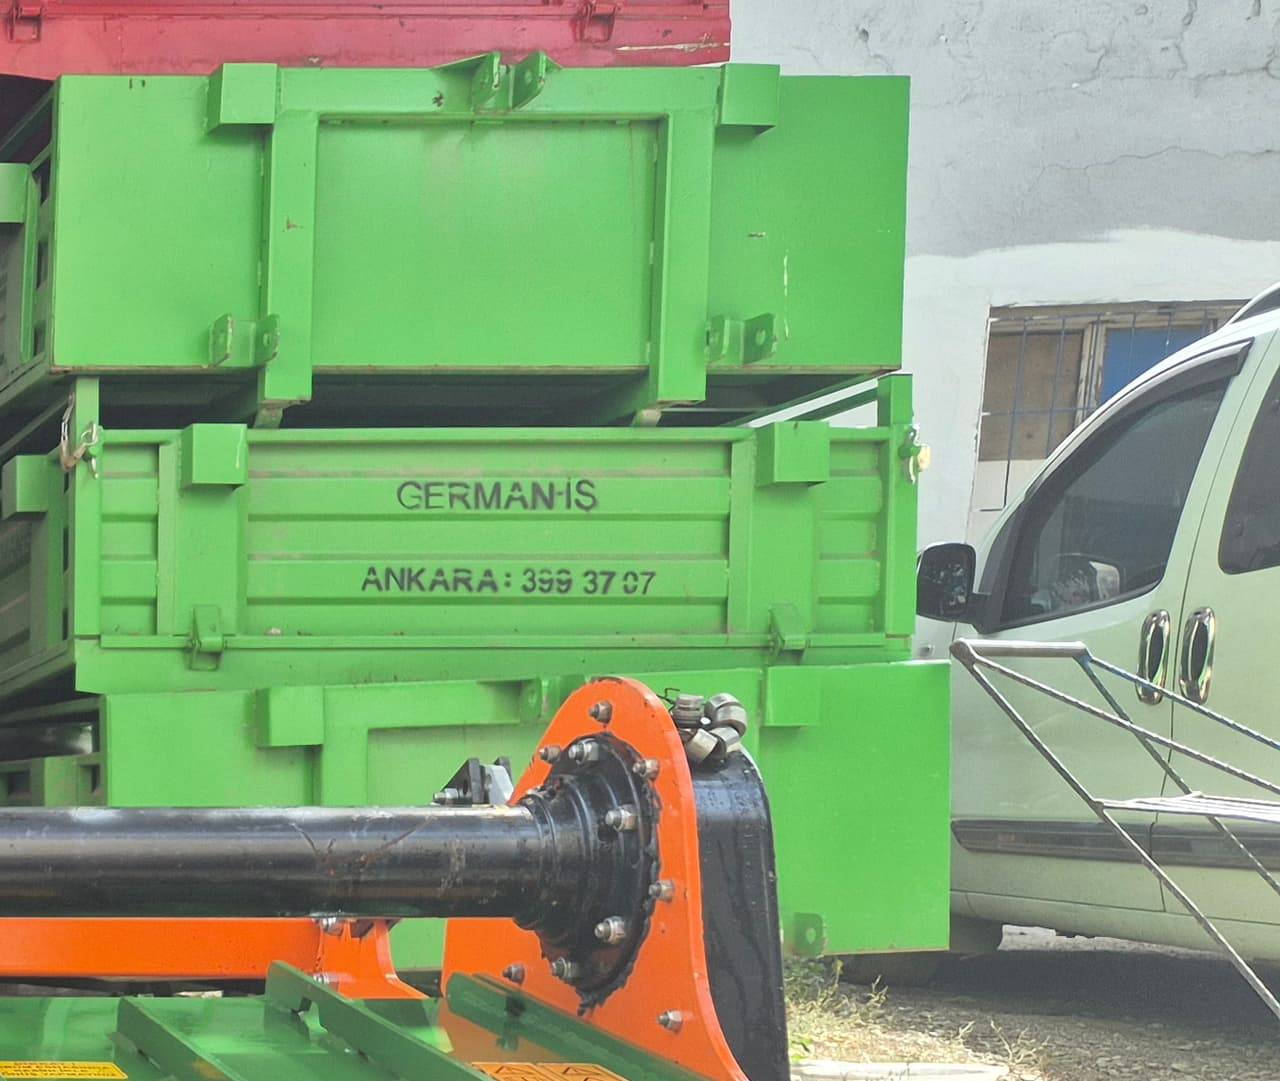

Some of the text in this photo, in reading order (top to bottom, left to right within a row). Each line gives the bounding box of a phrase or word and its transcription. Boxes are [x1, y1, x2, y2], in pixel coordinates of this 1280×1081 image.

[521, 568, 573, 594] 399
[582, 570, 616, 595] 37
[623, 570, 657, 595] 07
